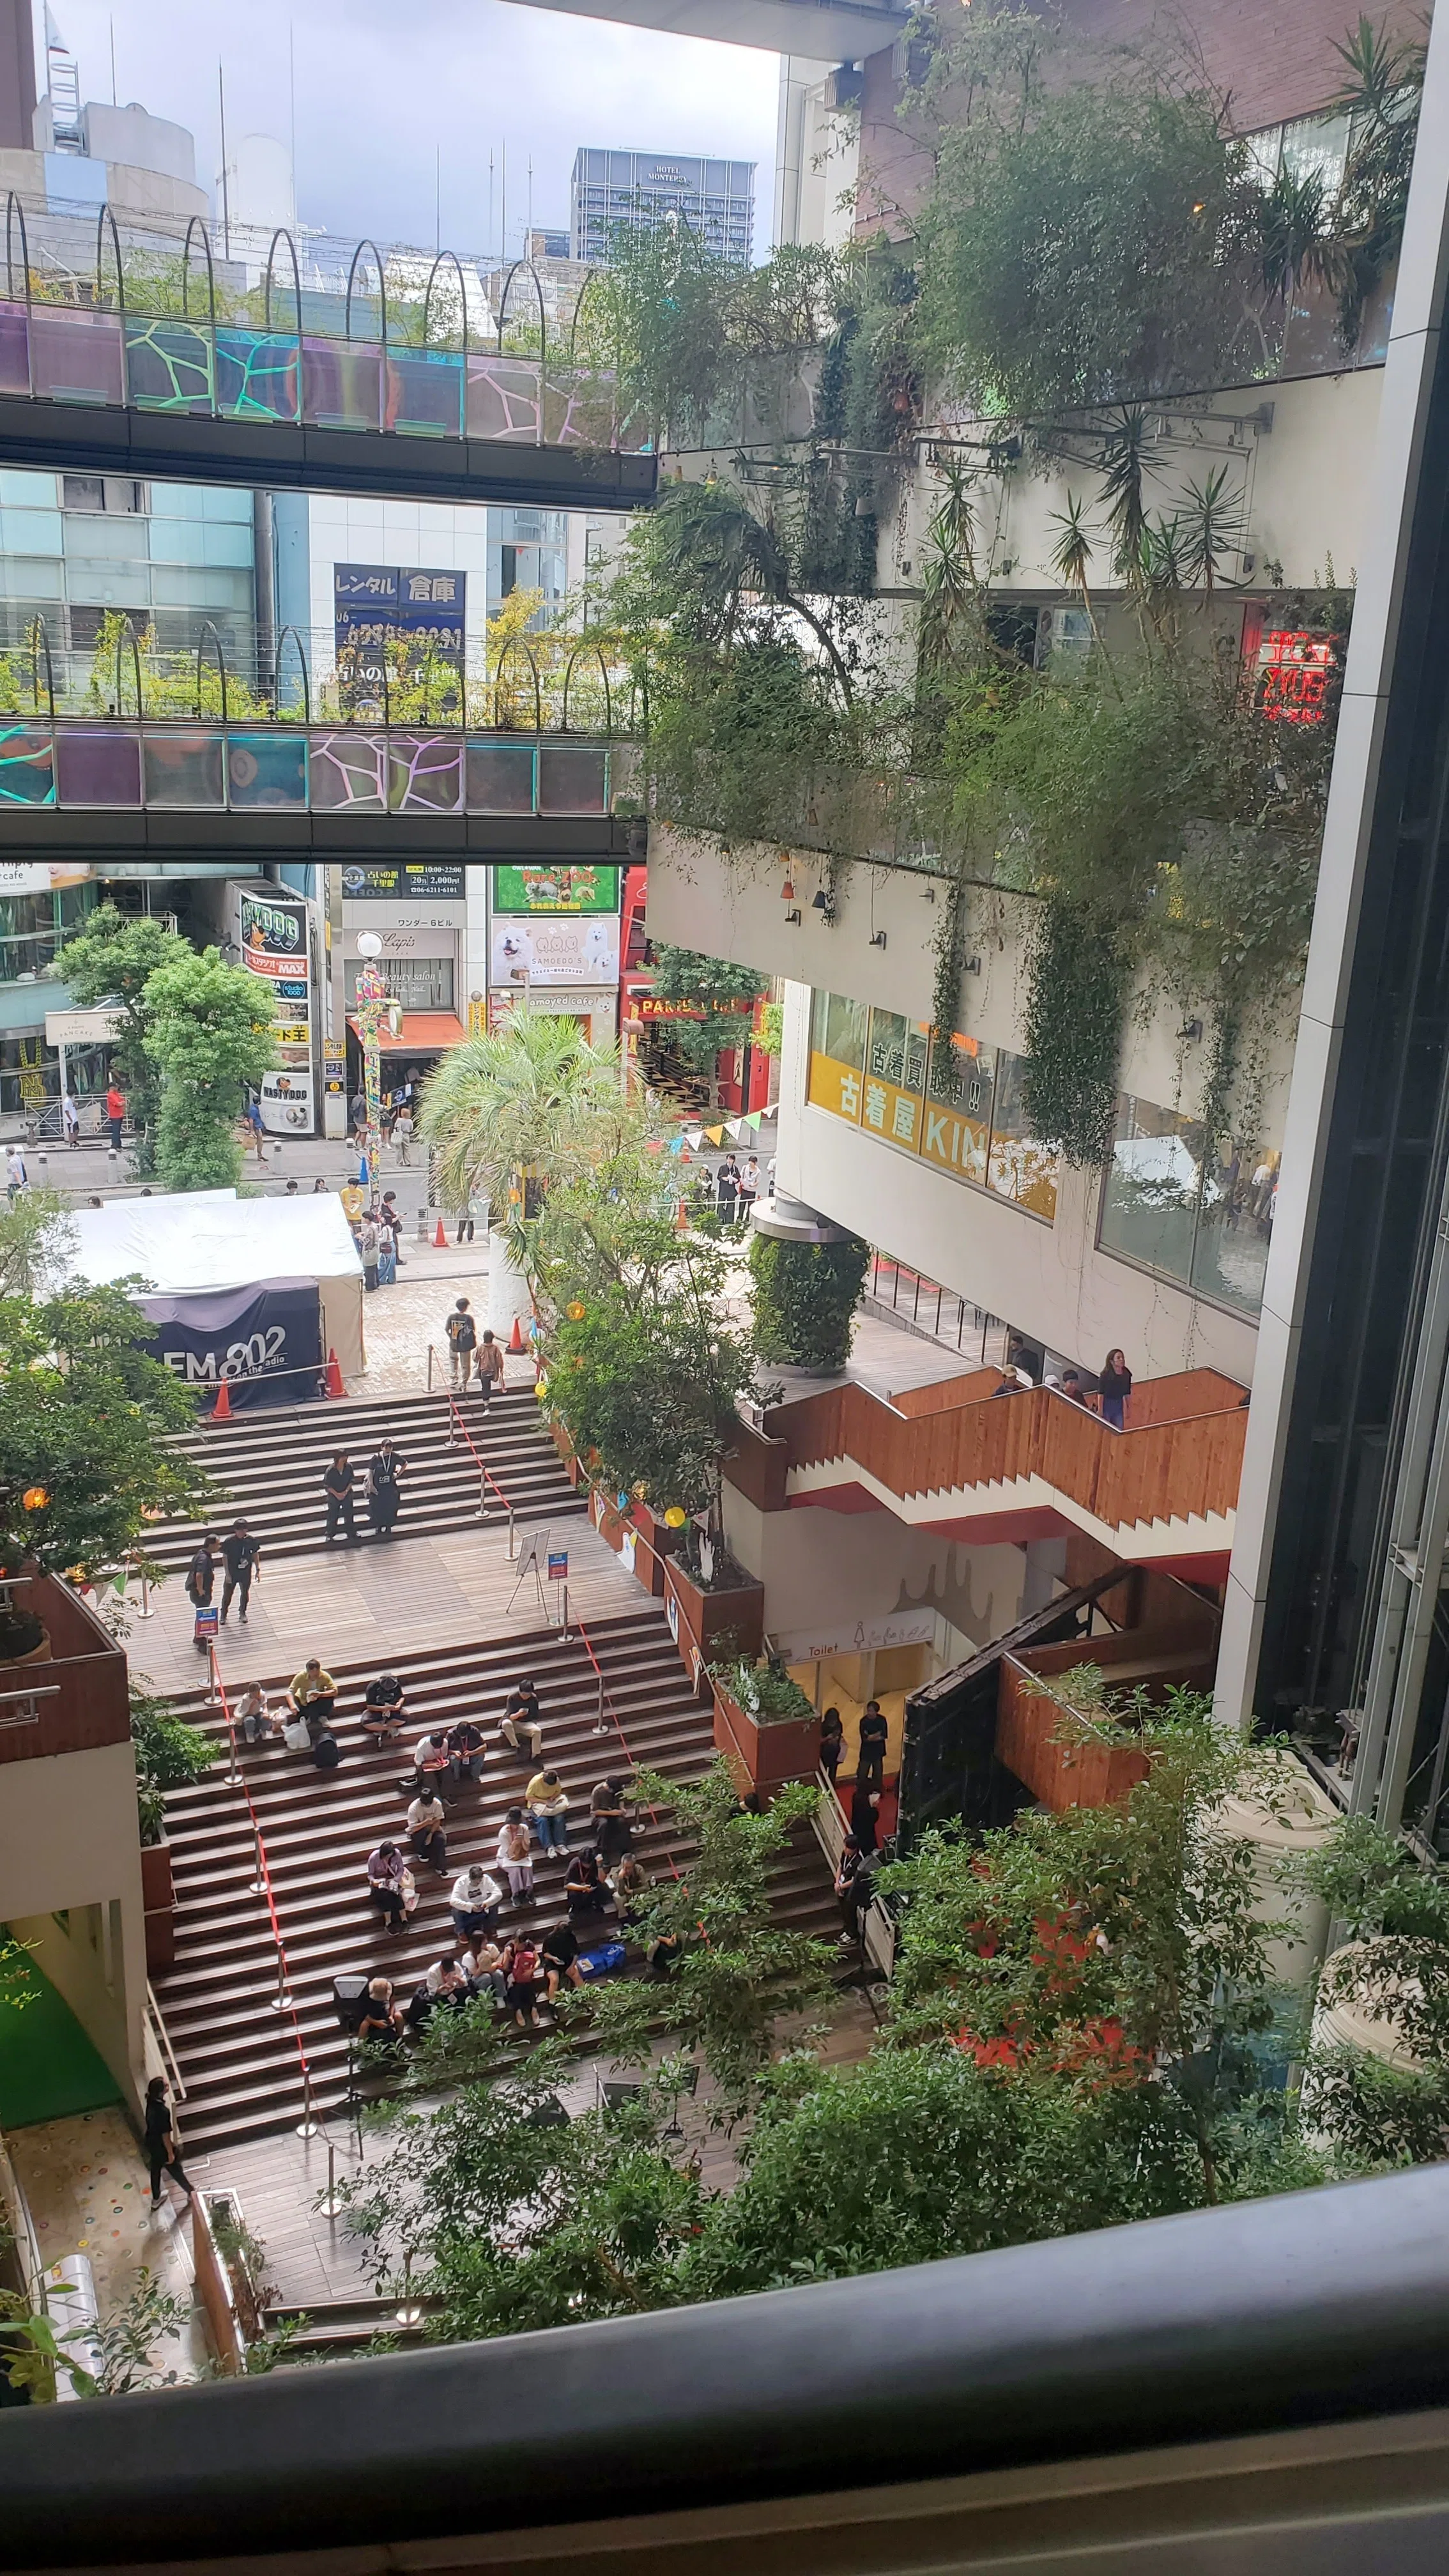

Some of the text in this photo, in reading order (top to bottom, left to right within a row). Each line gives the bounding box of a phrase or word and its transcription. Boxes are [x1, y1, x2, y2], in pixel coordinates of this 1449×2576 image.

[656, 165, 680, 174] HOTEL
[335, 575, 456, 602] レンタル 倉庫
[367, 871, 399, 879] 占いの館
[523, 870, 593, 884] Rare ZOO
[383, 933, 416, 951] Lapis
[278, 965, 305, 974] MAX
[382, 970, 436, 983] Beauty salon
[530, 994, 594, 1008] amoyed cafe
[840, 1073, 916, 1144] 古着屋
[263, 1357, 286, 1367] adio
[809, 1643, 839, 1657] Toilet
